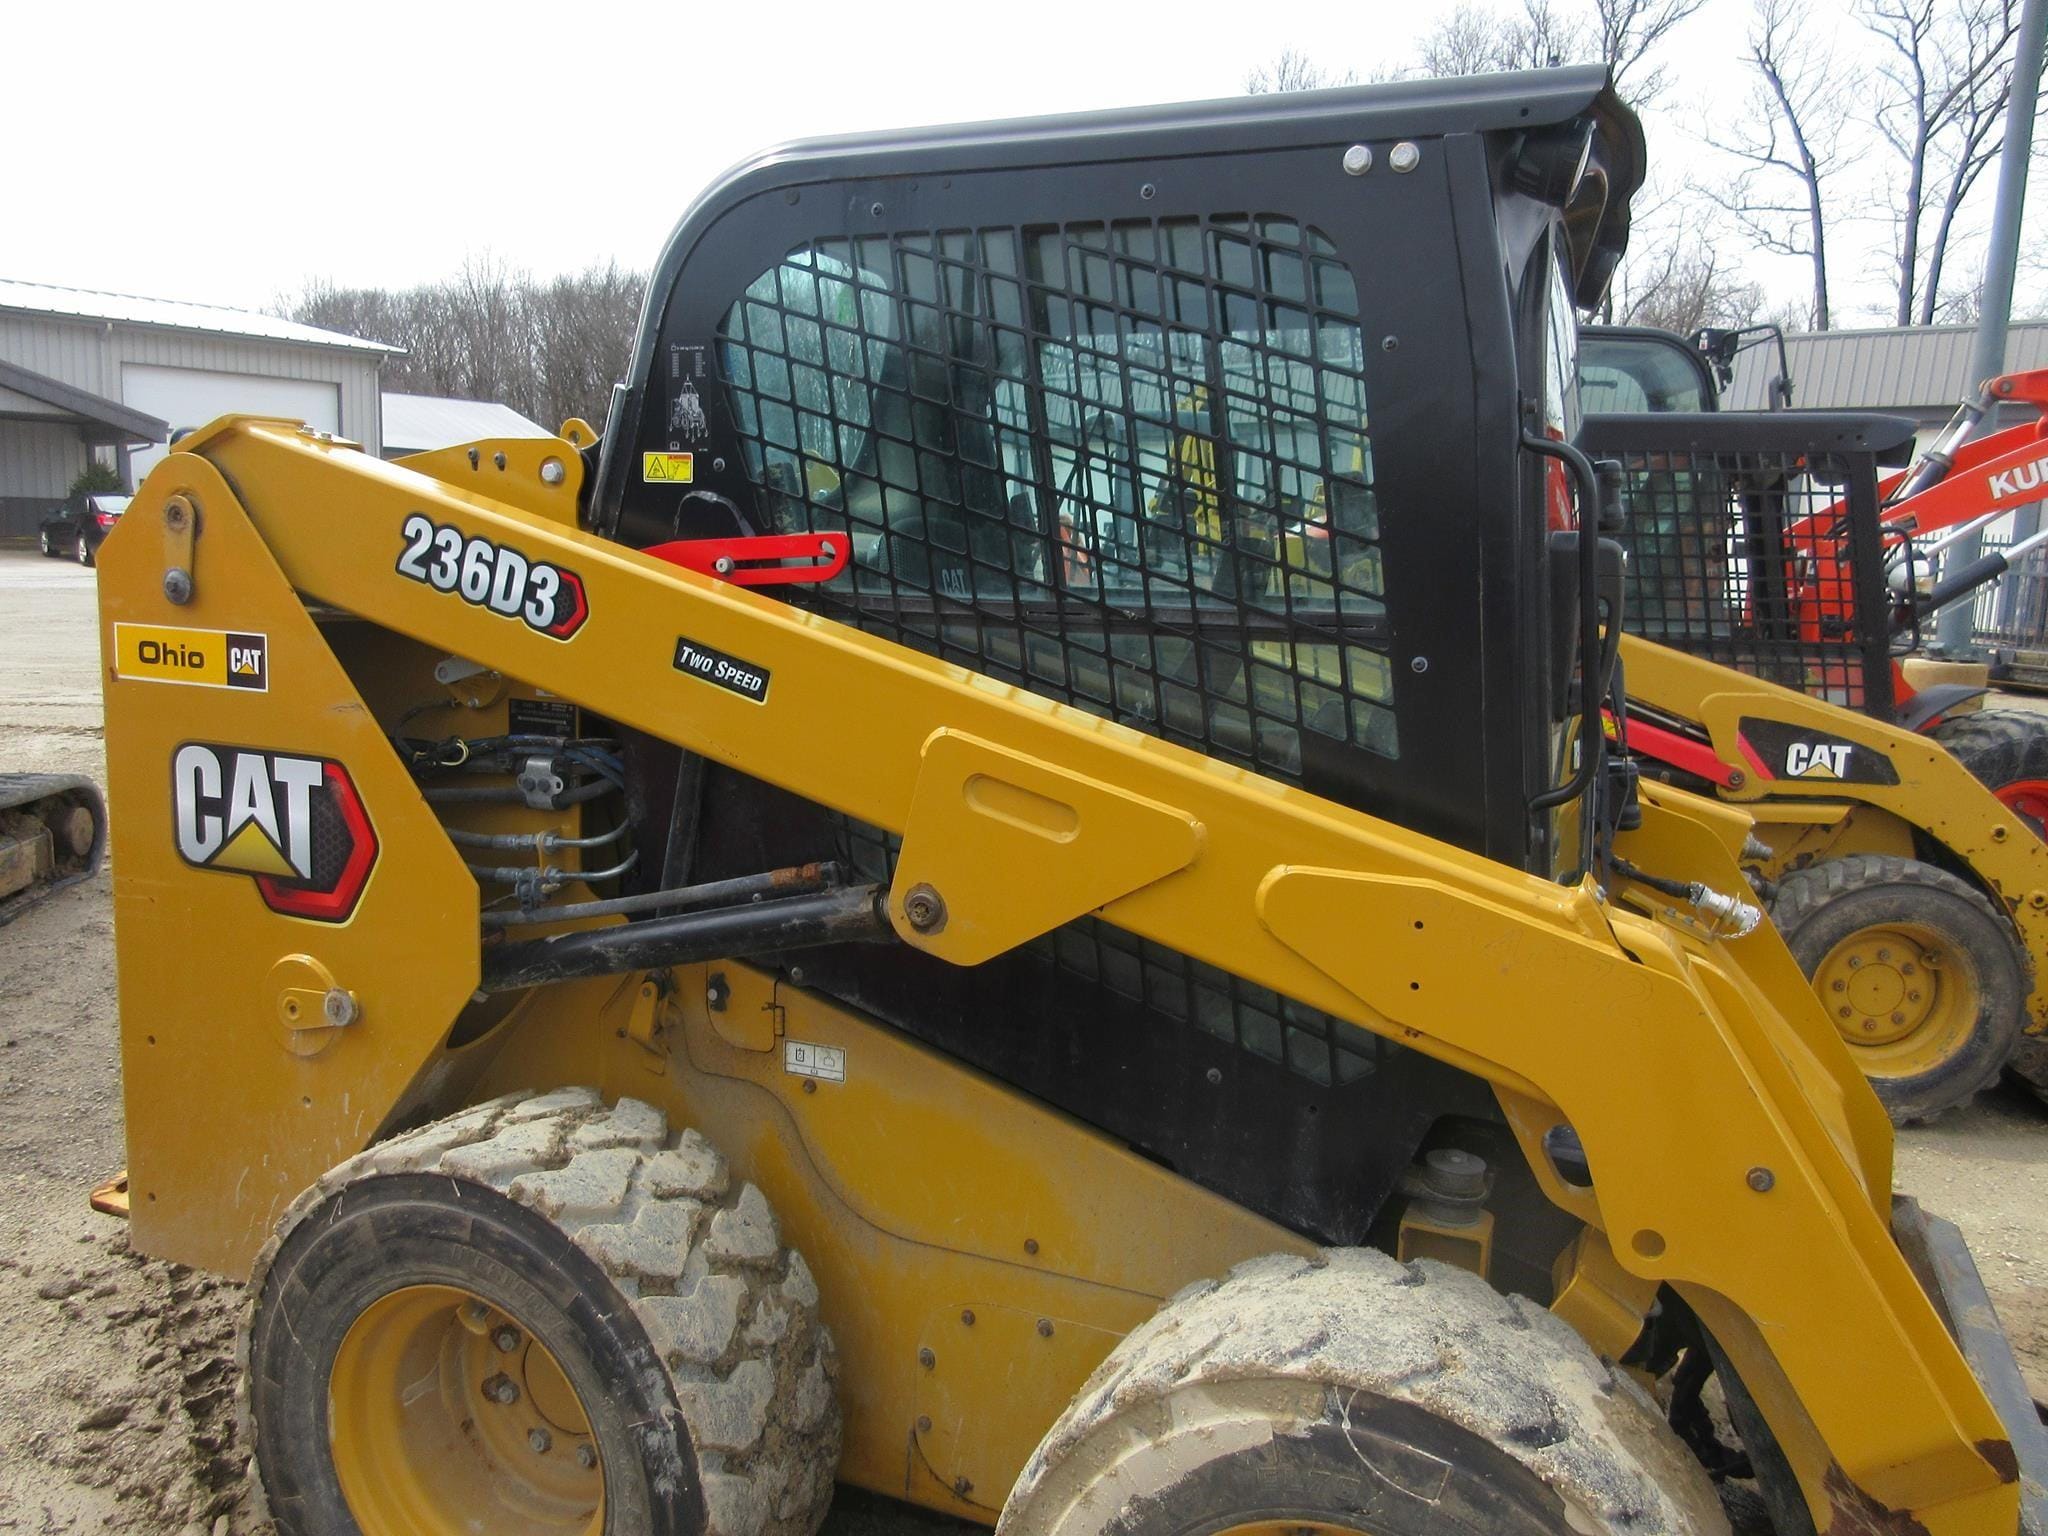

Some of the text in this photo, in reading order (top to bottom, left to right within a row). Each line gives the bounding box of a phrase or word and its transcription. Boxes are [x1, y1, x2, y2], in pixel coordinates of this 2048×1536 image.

[399, 516, 560, 627] 236D3
[138, 640, 262, 676] Ohio CAT
[1786, 742, 1852, 778] CAT
[175, 745, 323, 880] CAT
